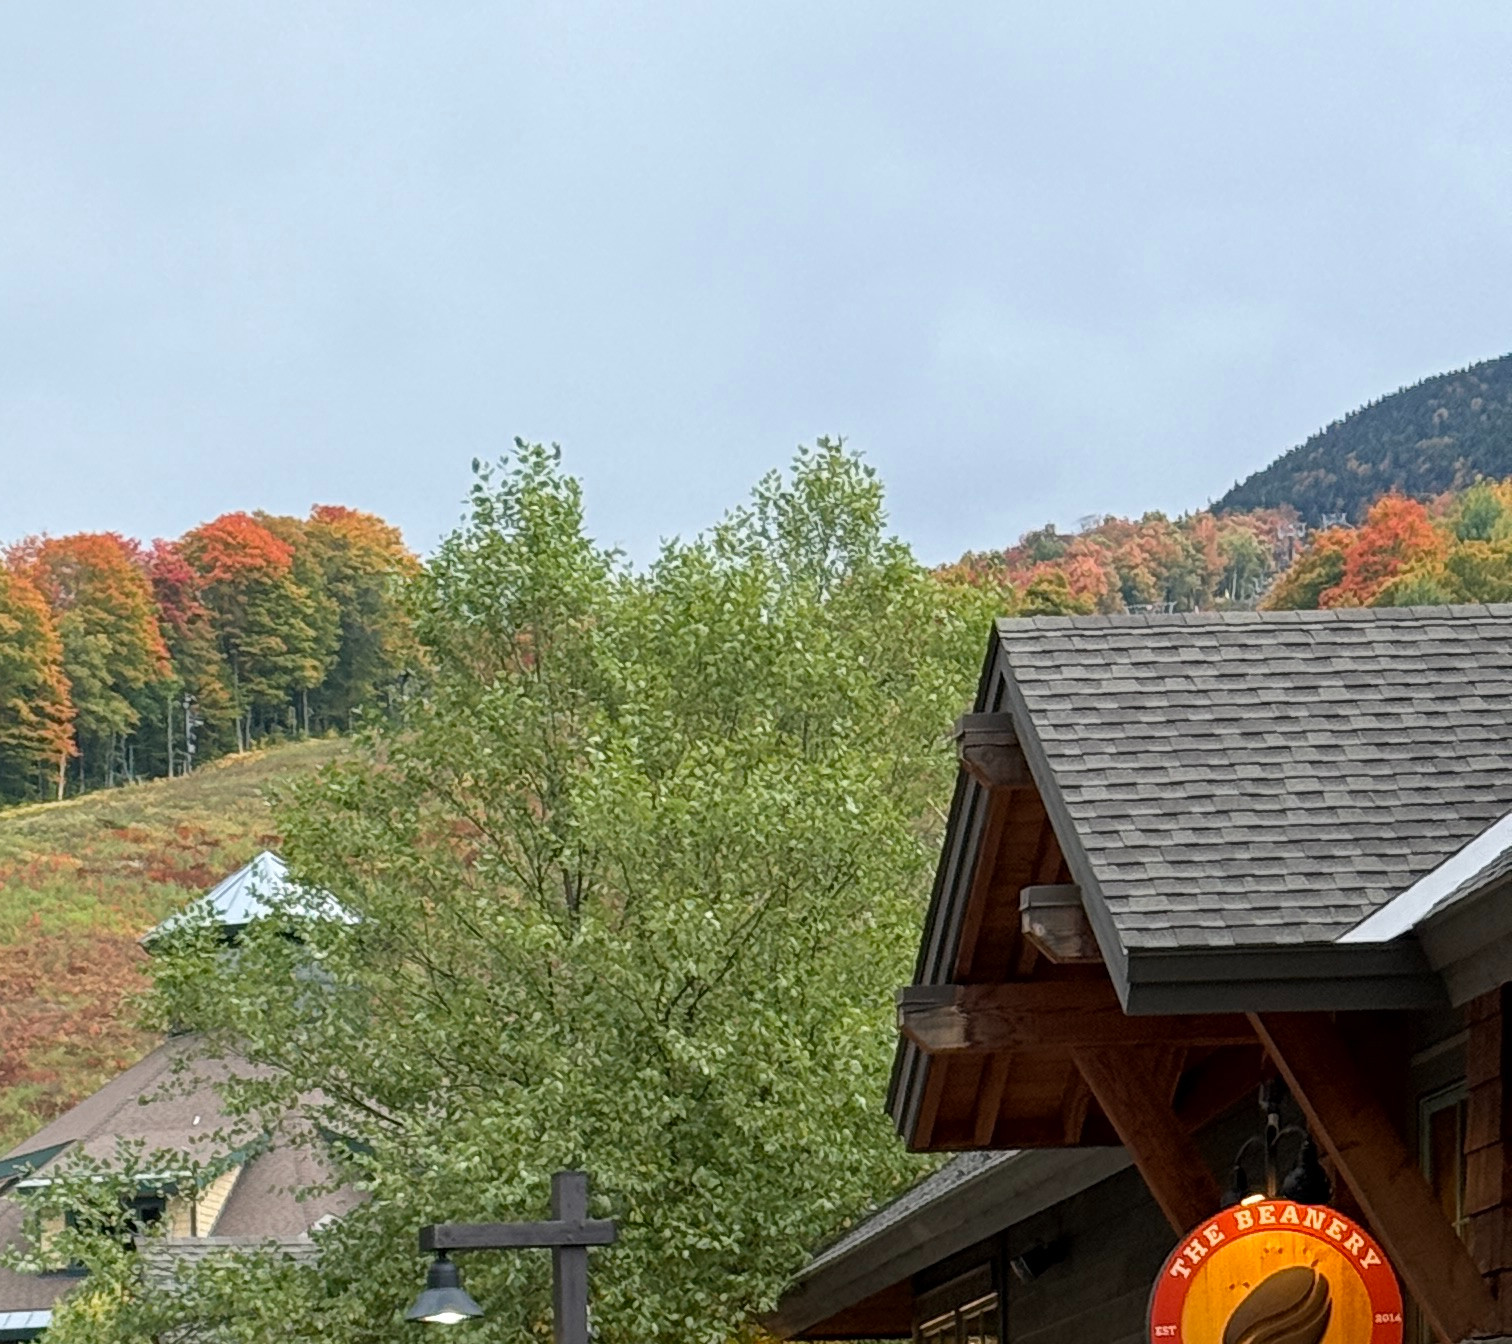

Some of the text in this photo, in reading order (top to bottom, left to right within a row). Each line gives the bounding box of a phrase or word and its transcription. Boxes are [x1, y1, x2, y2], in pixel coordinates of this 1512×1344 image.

[1169, 1205, 1382, 1280] THE BEANERY
[1154, 1324, 1178, 1336] EST
